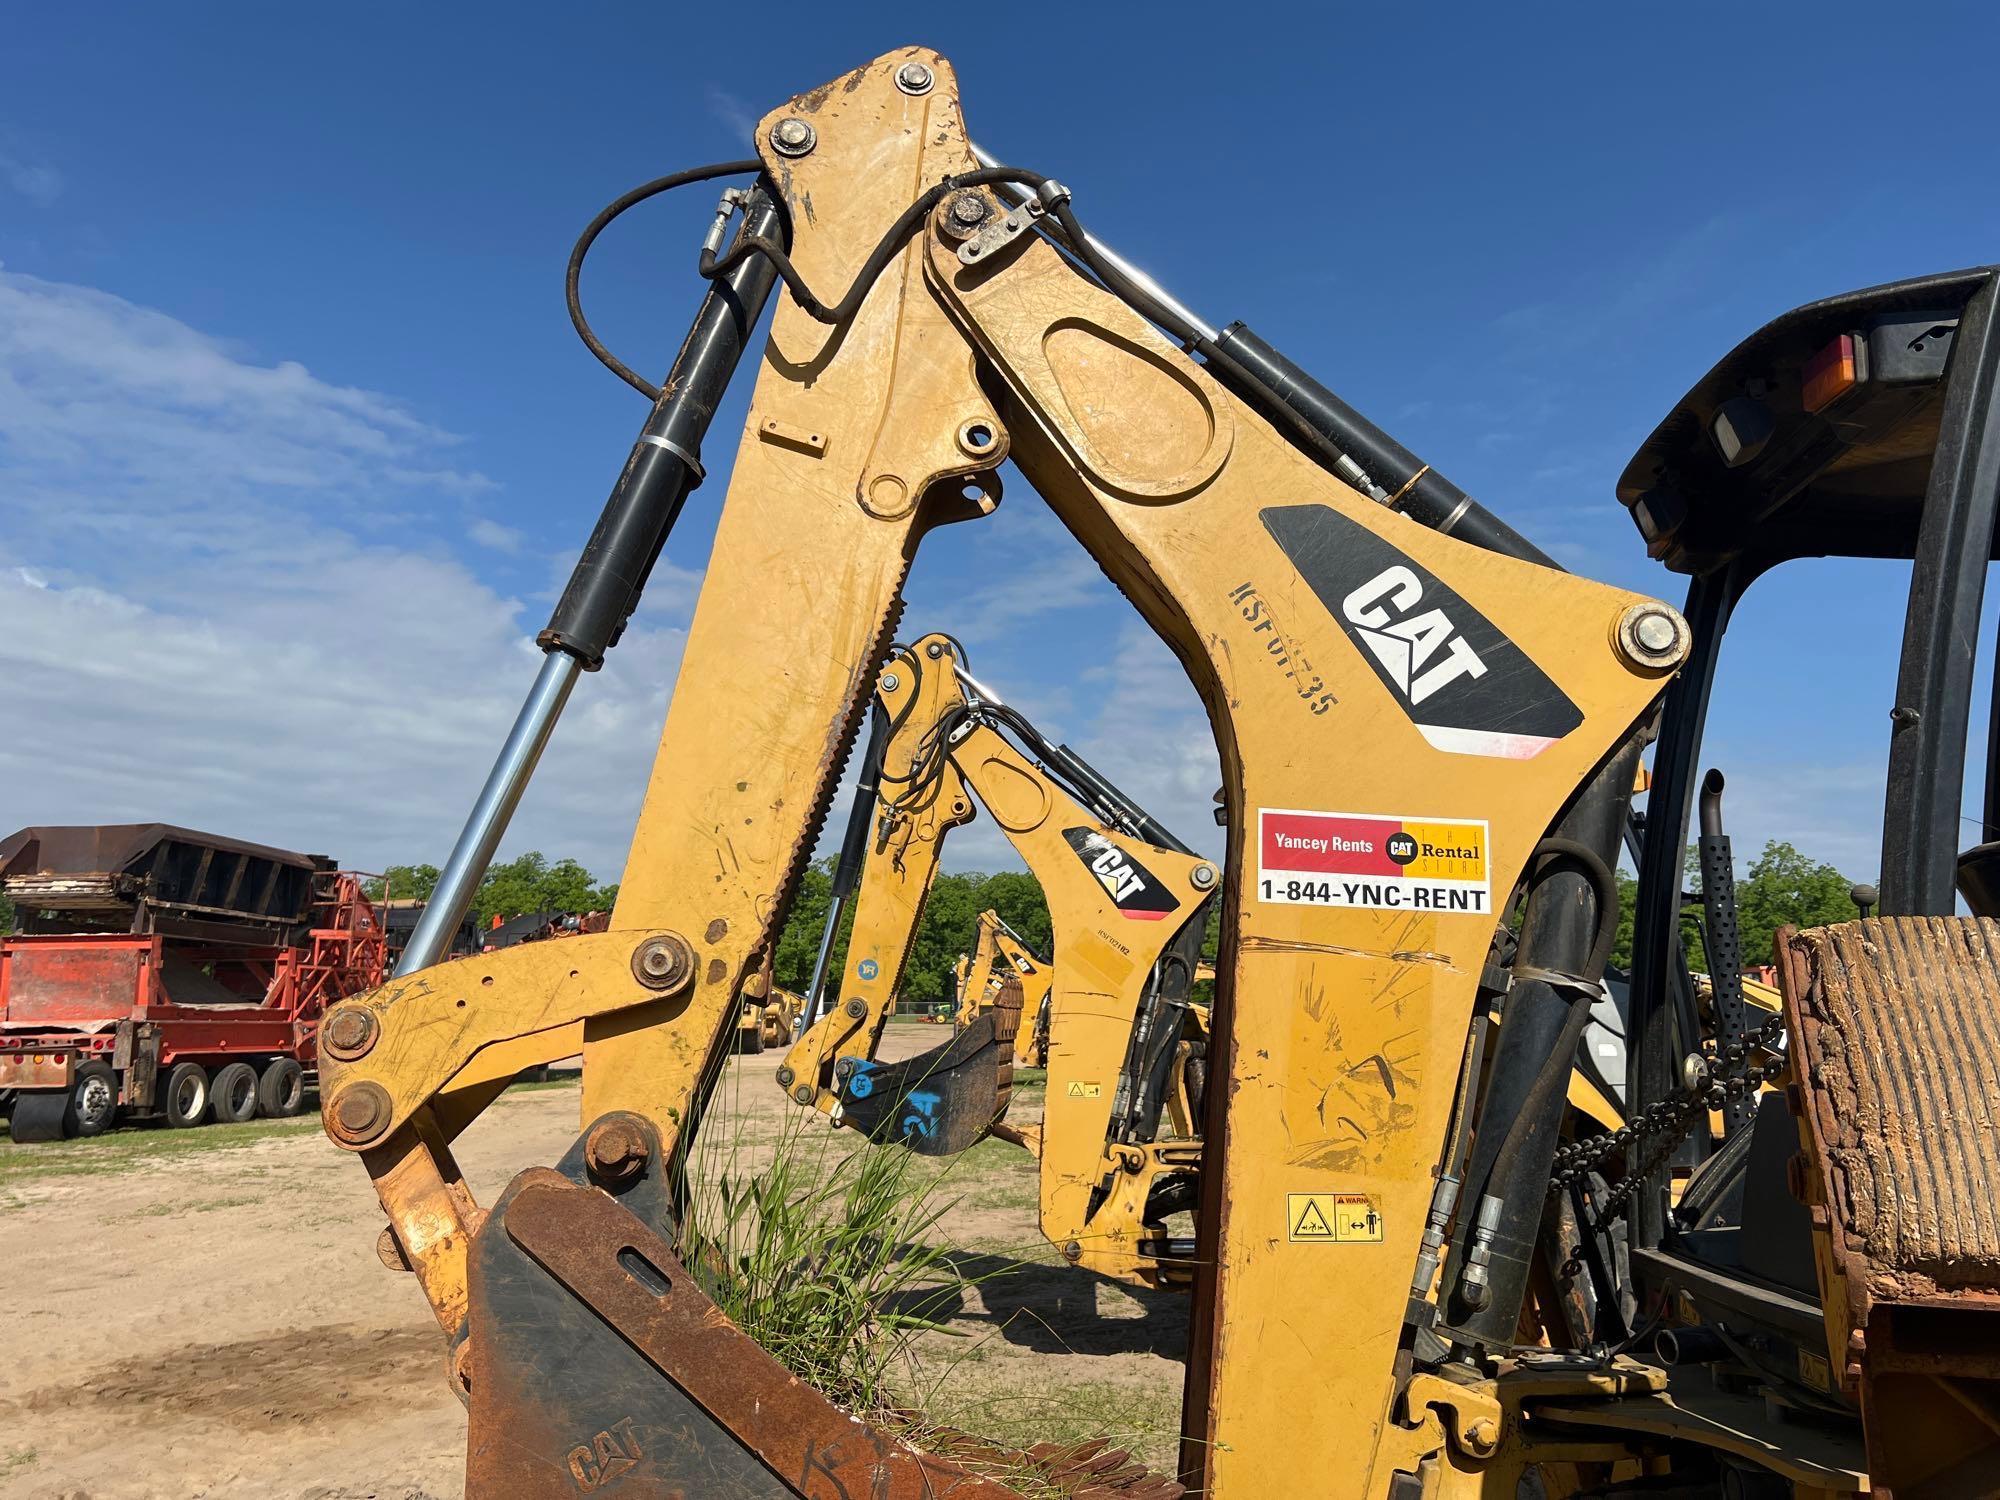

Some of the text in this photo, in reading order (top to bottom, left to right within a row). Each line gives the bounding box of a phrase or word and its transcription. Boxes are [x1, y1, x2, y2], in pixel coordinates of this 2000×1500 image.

[1342, 565, 1488, 706] CAT
[1275, 833, 1373, 853] Yancey Rents
[1390, 842, 1479, 859] CAT Rental
[1092, 848, 1145, 903] CAT
[1261, 880, 1486, 910] 1-844-YNC-RENT
[567, 1416, 644, 1495] CAT
